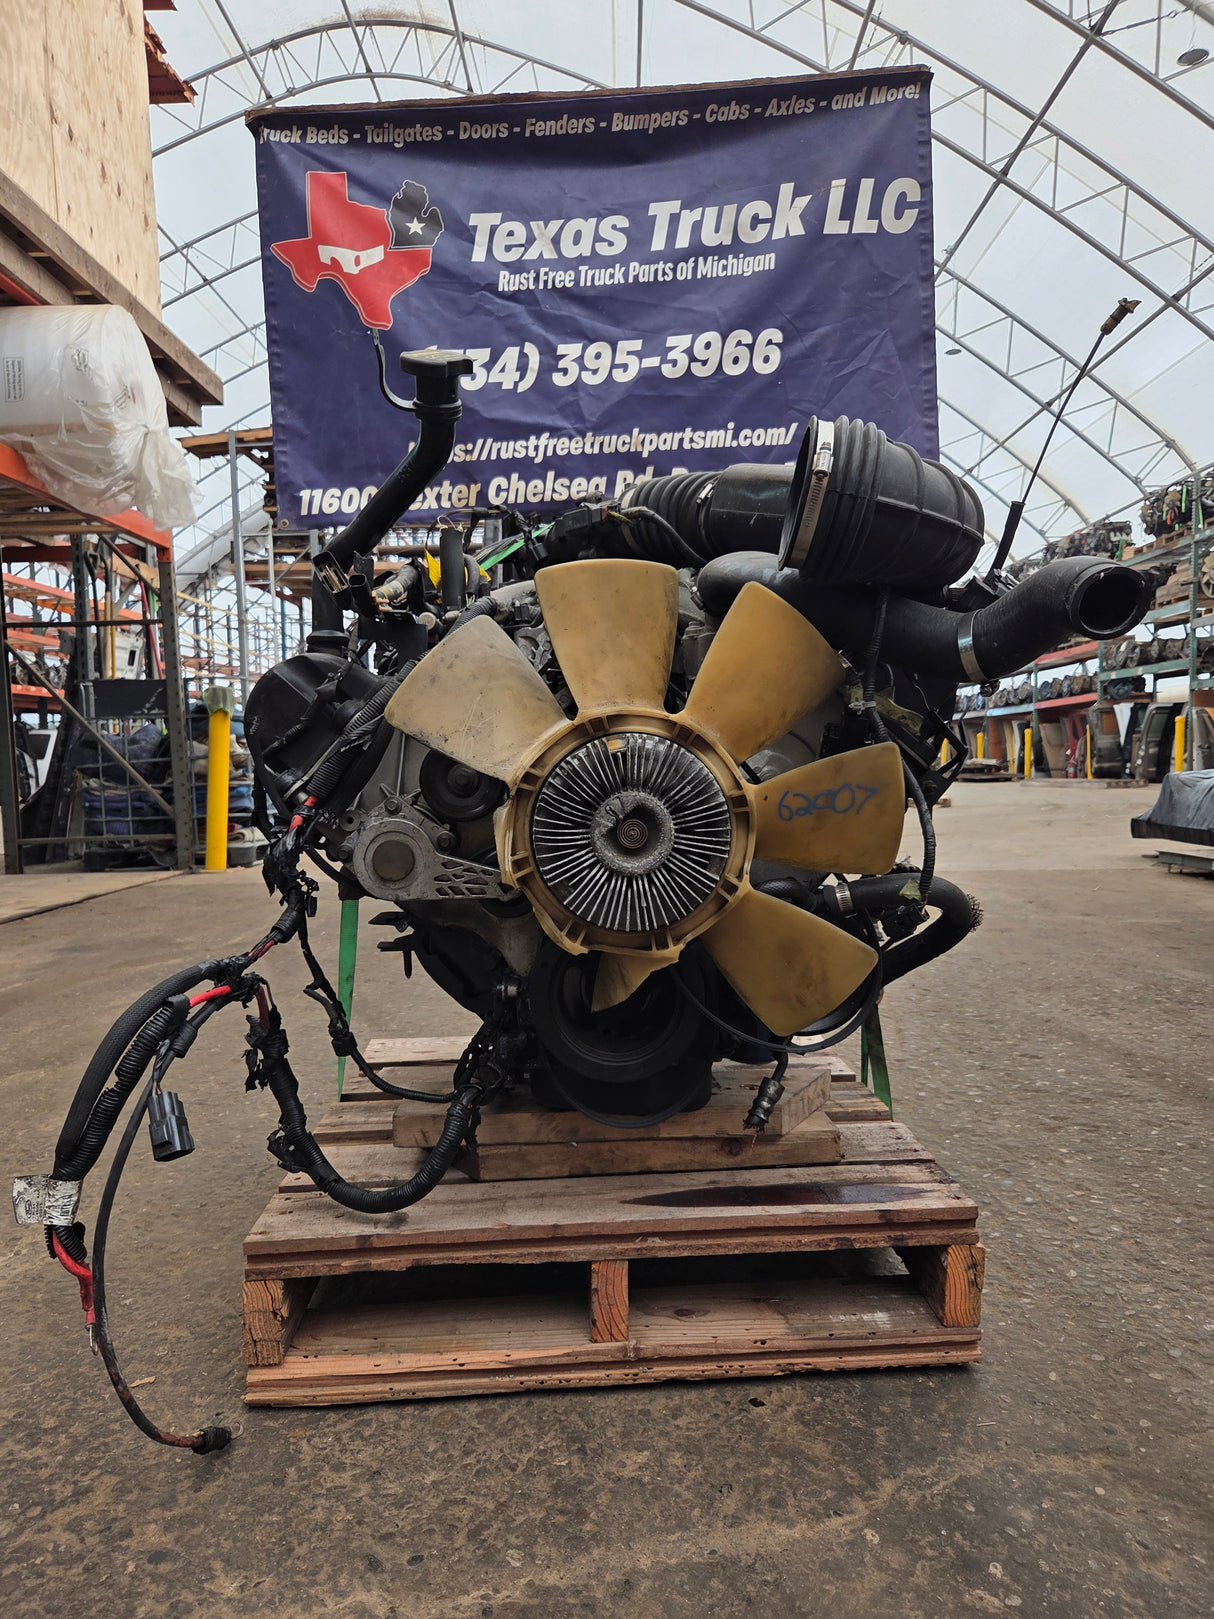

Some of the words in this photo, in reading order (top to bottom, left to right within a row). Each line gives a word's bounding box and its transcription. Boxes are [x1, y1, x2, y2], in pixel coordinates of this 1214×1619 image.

[306, 126, 349, 145] Beds
[364, 123, 443, 147] Tailgates
[459, 119, 509, 139] Doors
[525, 114, 595, 137] Fenders
[611, 109, 689, 134] Bumpers
[705, 101, 750, 123] Cabs
[764, 95, 815, 118] Axles
[831, 86, 865, 110] and
[869, 82, 921, 106] More!
[468, 212, 629, 264] Texas
[648, 182, 813, 252] Truck
[823, 177, 921, 235] LLC
[498, 269, 536, 292] Rust
[538, 266, 575, 290] Free
[579, 263, 625, 287] Truck
[628, 259, 673, 283] Parts
[676, 256, 696, 281] of
[696, 251, 776, 279] Michigan
[423, 341, 540, 393] 34)
[552, 328, 784, 387] 395-3966
[408, 422, 799, 466] s://rustfreetruckpartsmi.com/
[778, 783, 880, 822] 62007
